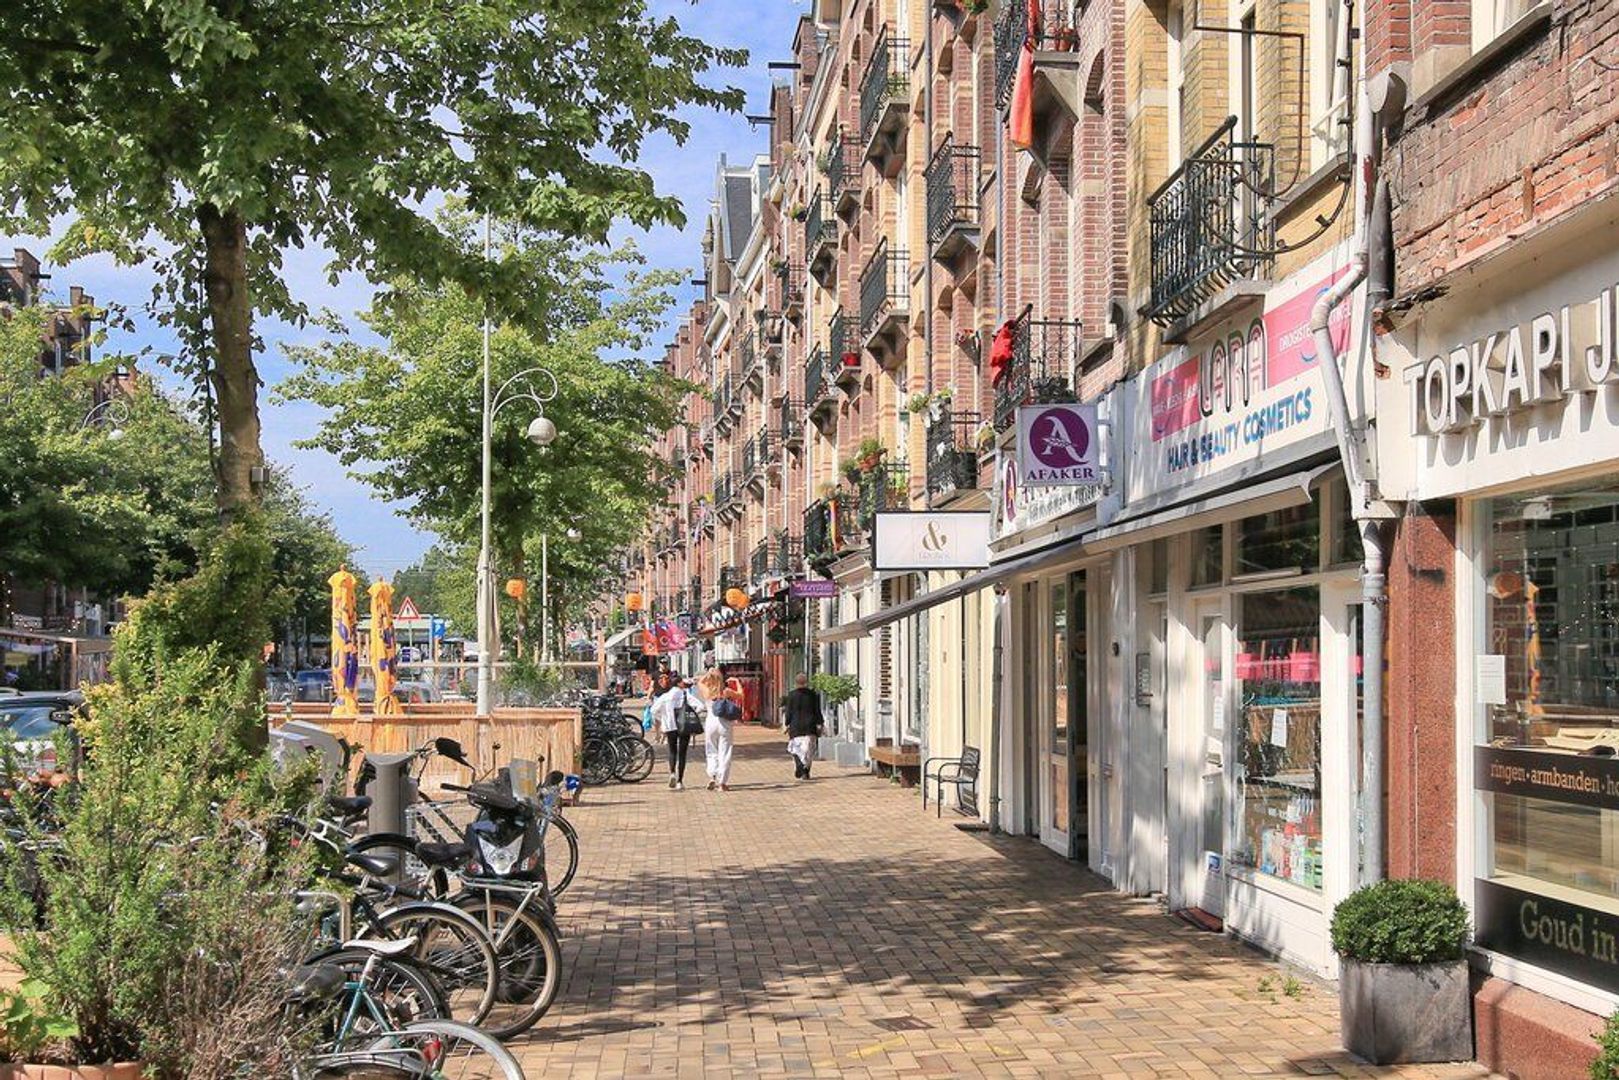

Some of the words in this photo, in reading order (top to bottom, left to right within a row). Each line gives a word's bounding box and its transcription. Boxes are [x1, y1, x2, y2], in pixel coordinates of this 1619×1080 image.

[1403, 304, 1571, 436] TOPKAPI
[1167, 442, 1189, 474] HAIR
[1190, 438, 1199, 466] &
[1200, 421, 1241, 463] BEAUTY
[1243, 386, 1312, 445] COSMETICS
[1027, 467, 1095, 481] AFAKER
[922, 520, 947, 552] &
[1530, 766, 1600, 792] armbanden
[1521, 899, 1586, 955] Goud
[1592, 917, 1618, 964] in
